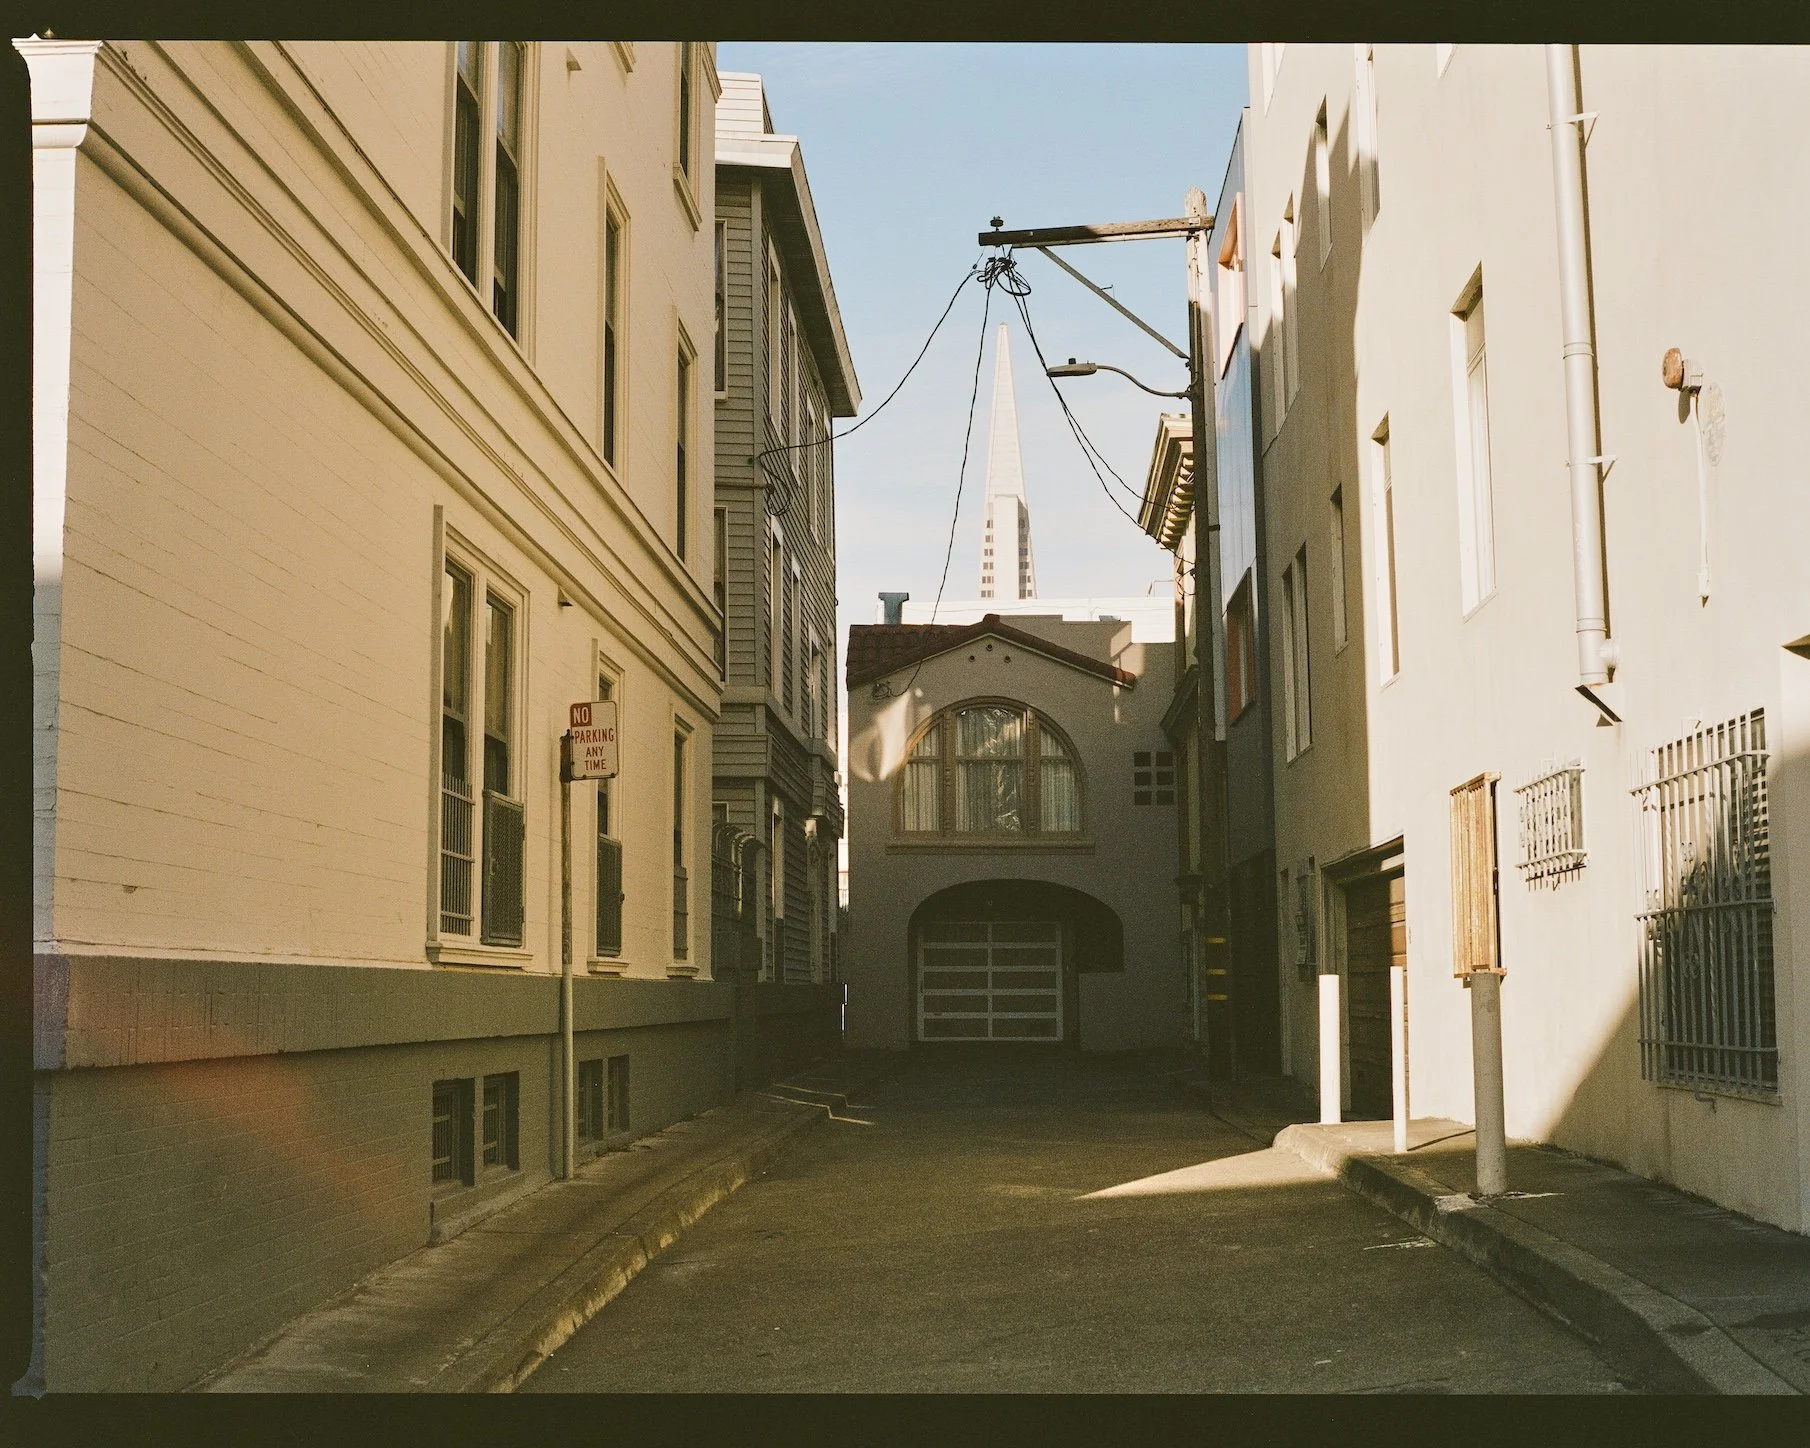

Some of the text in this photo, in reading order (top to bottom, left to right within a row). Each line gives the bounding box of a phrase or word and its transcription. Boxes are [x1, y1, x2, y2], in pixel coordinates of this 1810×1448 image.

[573, 706, 589, 724] NO
[574, 727, 614, 744] PARKING
[586, 746, 604, 757] ANY
[584, 759, 607, 770] TIME
